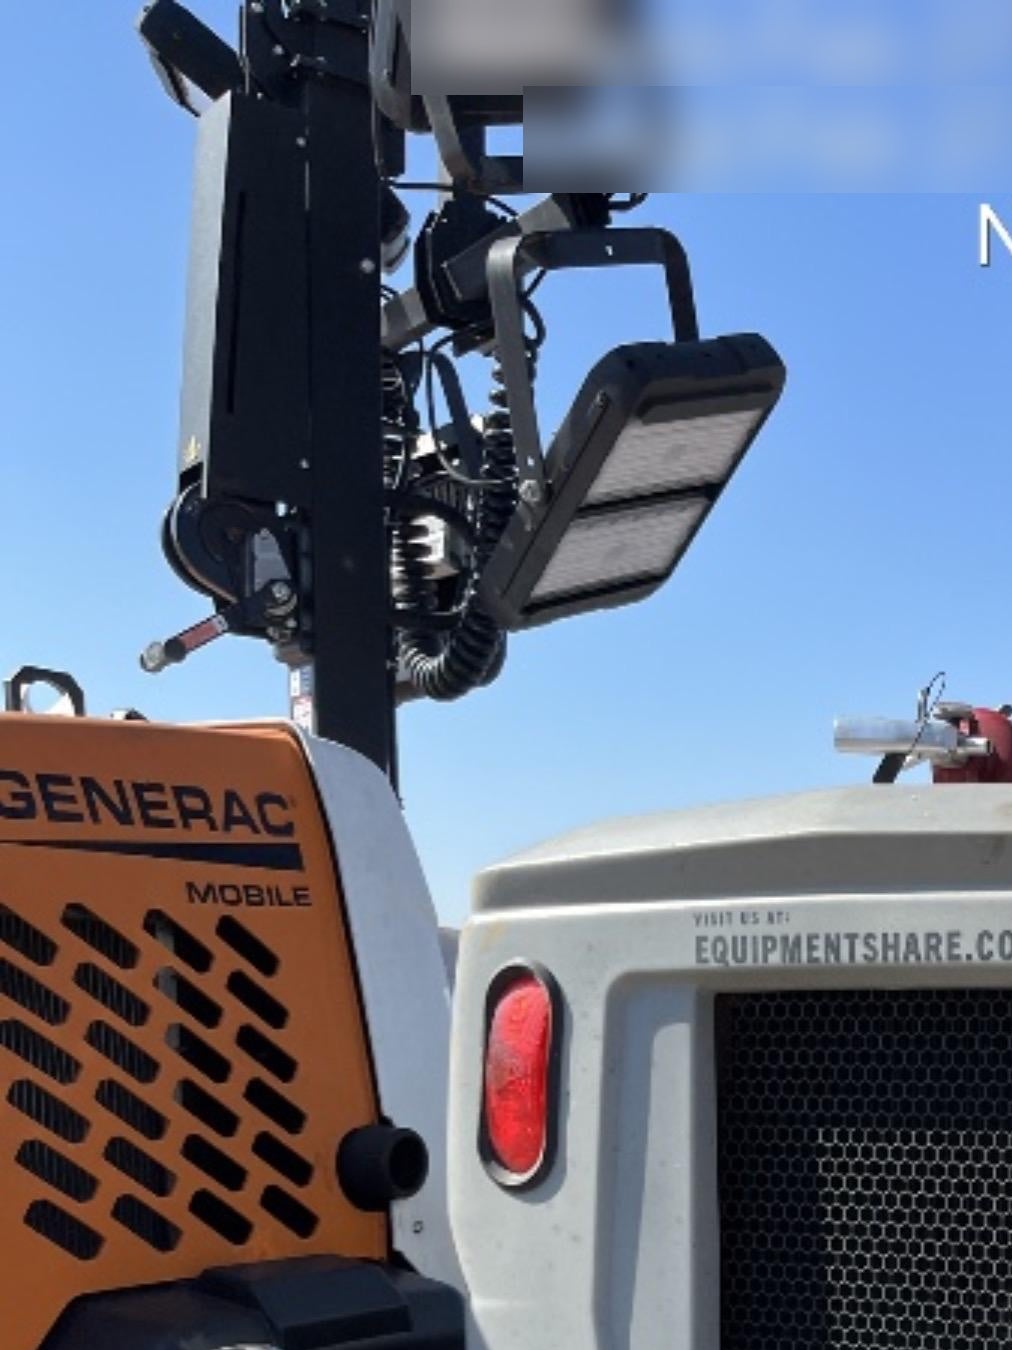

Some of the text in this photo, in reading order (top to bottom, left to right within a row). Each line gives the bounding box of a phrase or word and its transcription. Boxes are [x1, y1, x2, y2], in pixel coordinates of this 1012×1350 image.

[0, 769, 296, 838] GENERAC
[185, 880, 313, 908] MOBILE
[693, 911, 733, 928] VISIT
